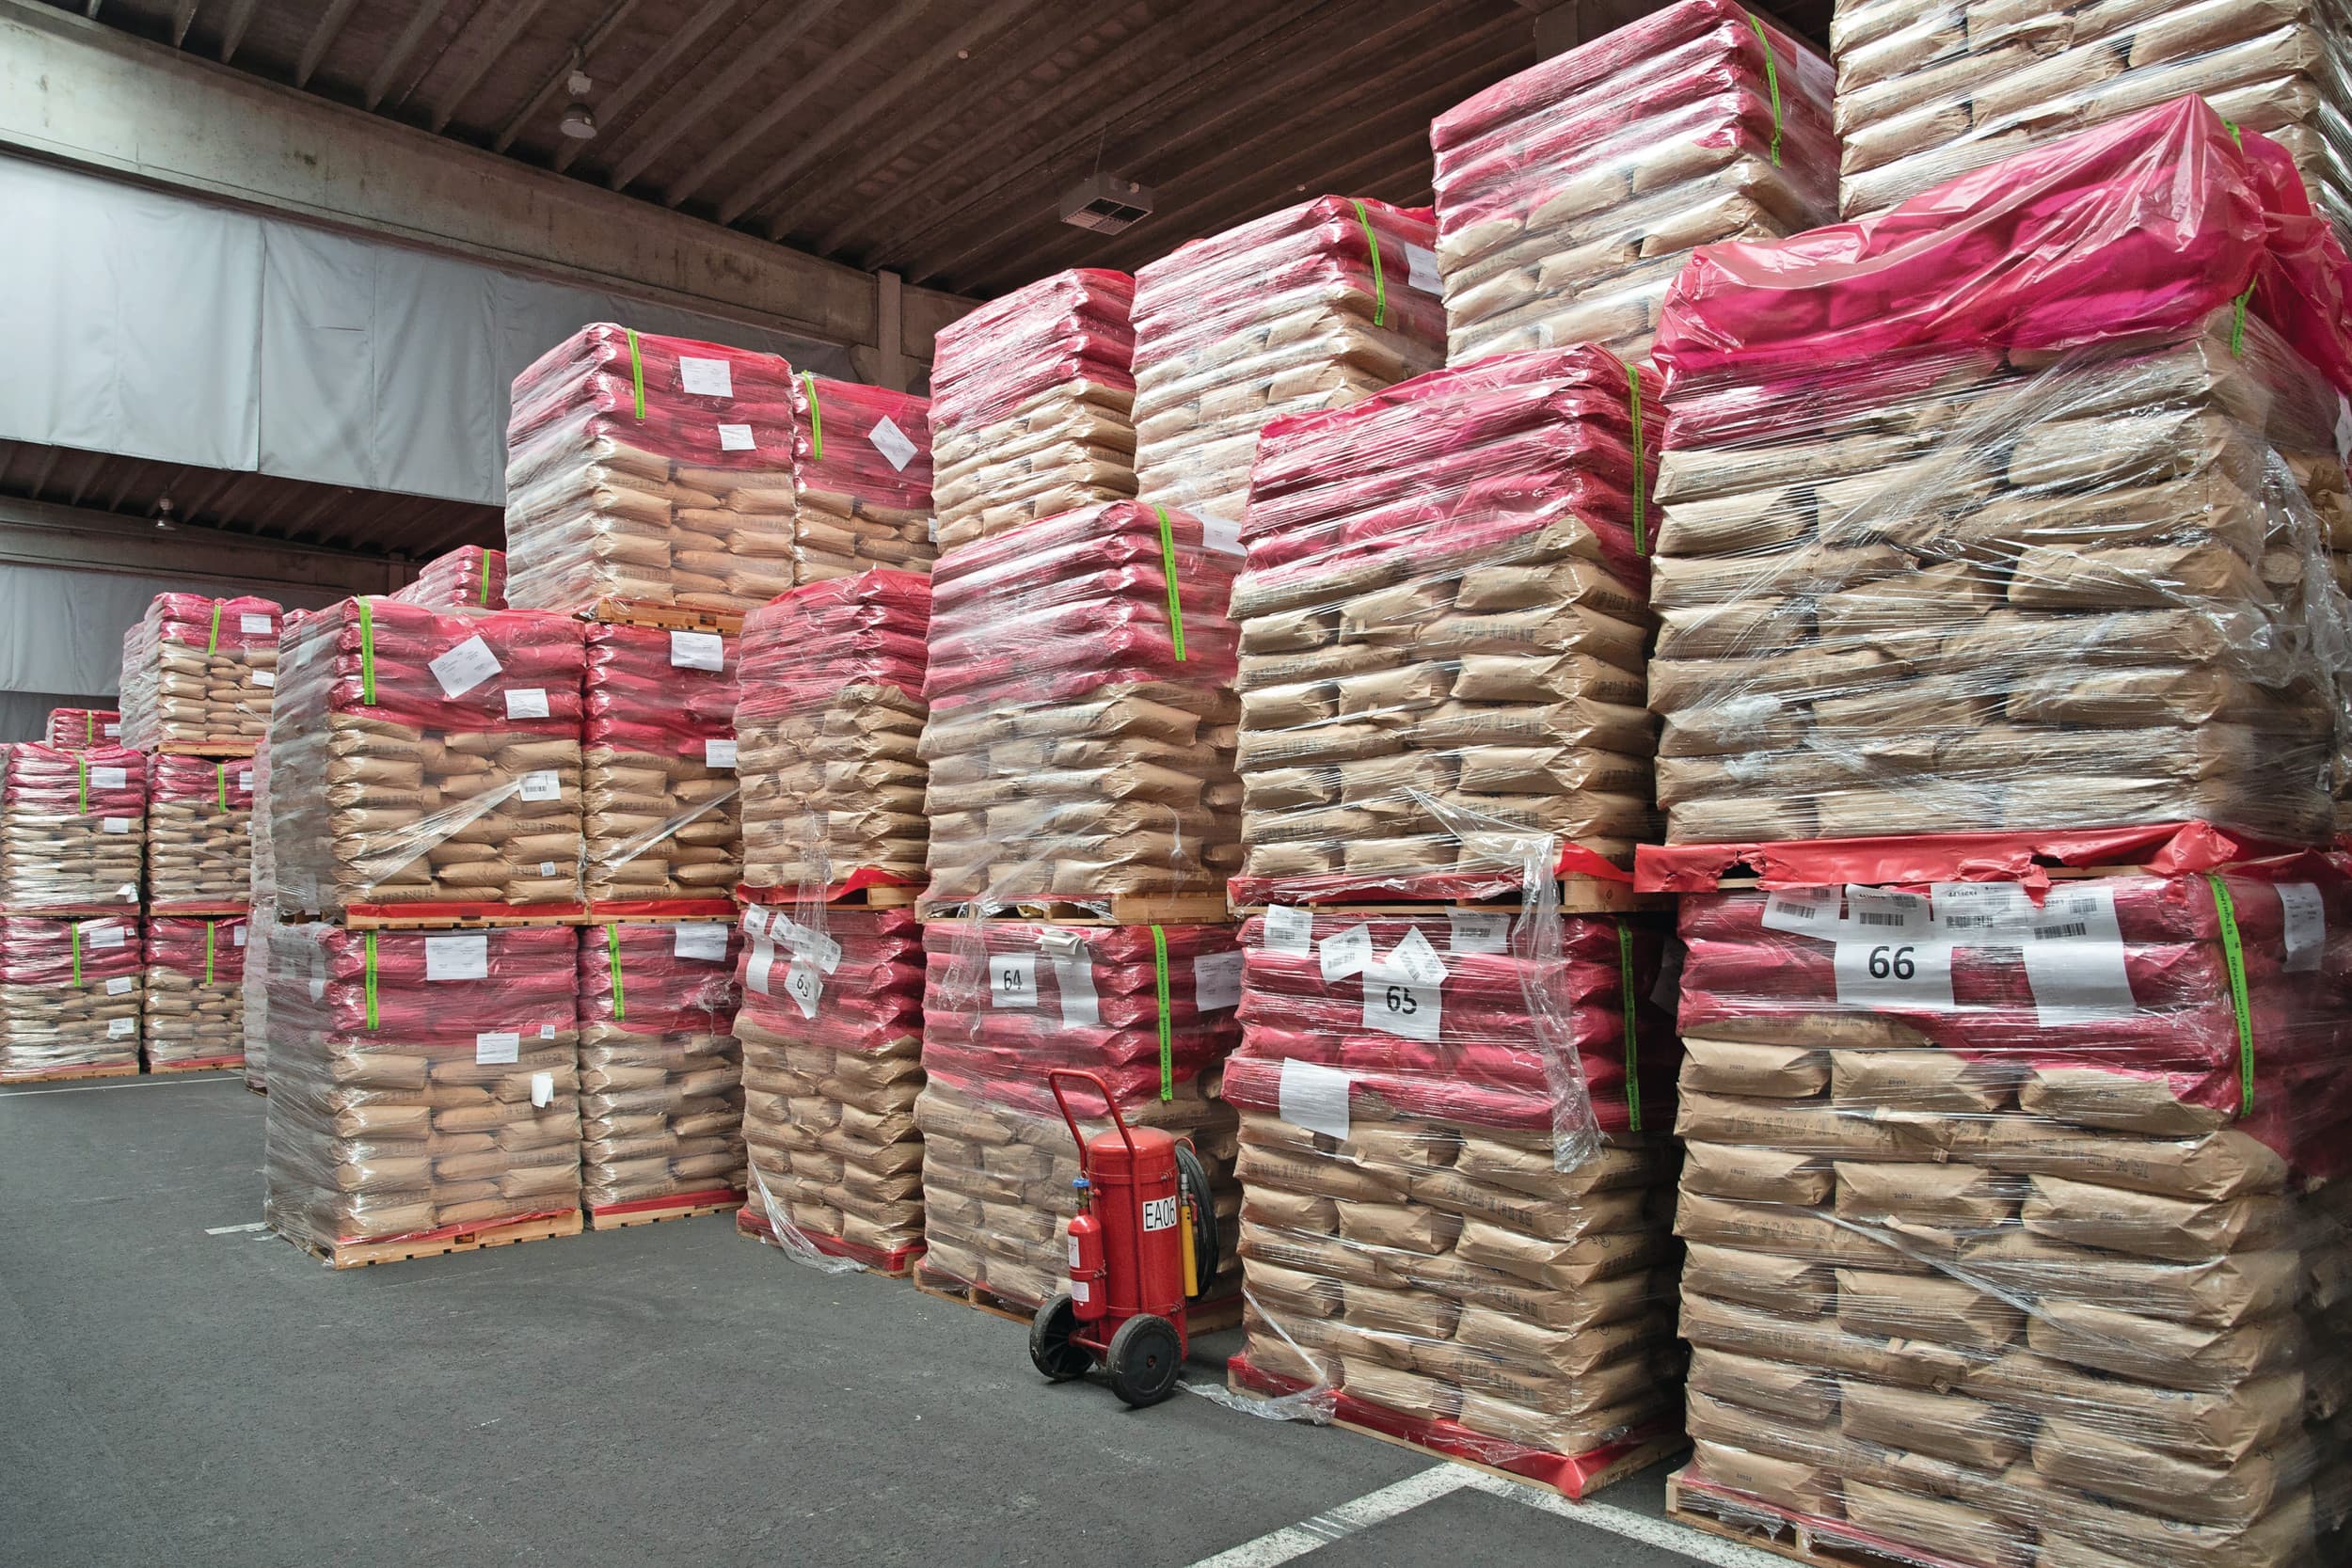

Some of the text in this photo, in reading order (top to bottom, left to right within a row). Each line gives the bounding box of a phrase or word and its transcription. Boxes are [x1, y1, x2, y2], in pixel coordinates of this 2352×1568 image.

[1868, 945, 1915, 980] 66
[1004, 969, 1023, 990] 64
[1386, 985, 1417, 1014] 65
[1145, 1197, 1175, 1229] EA06
